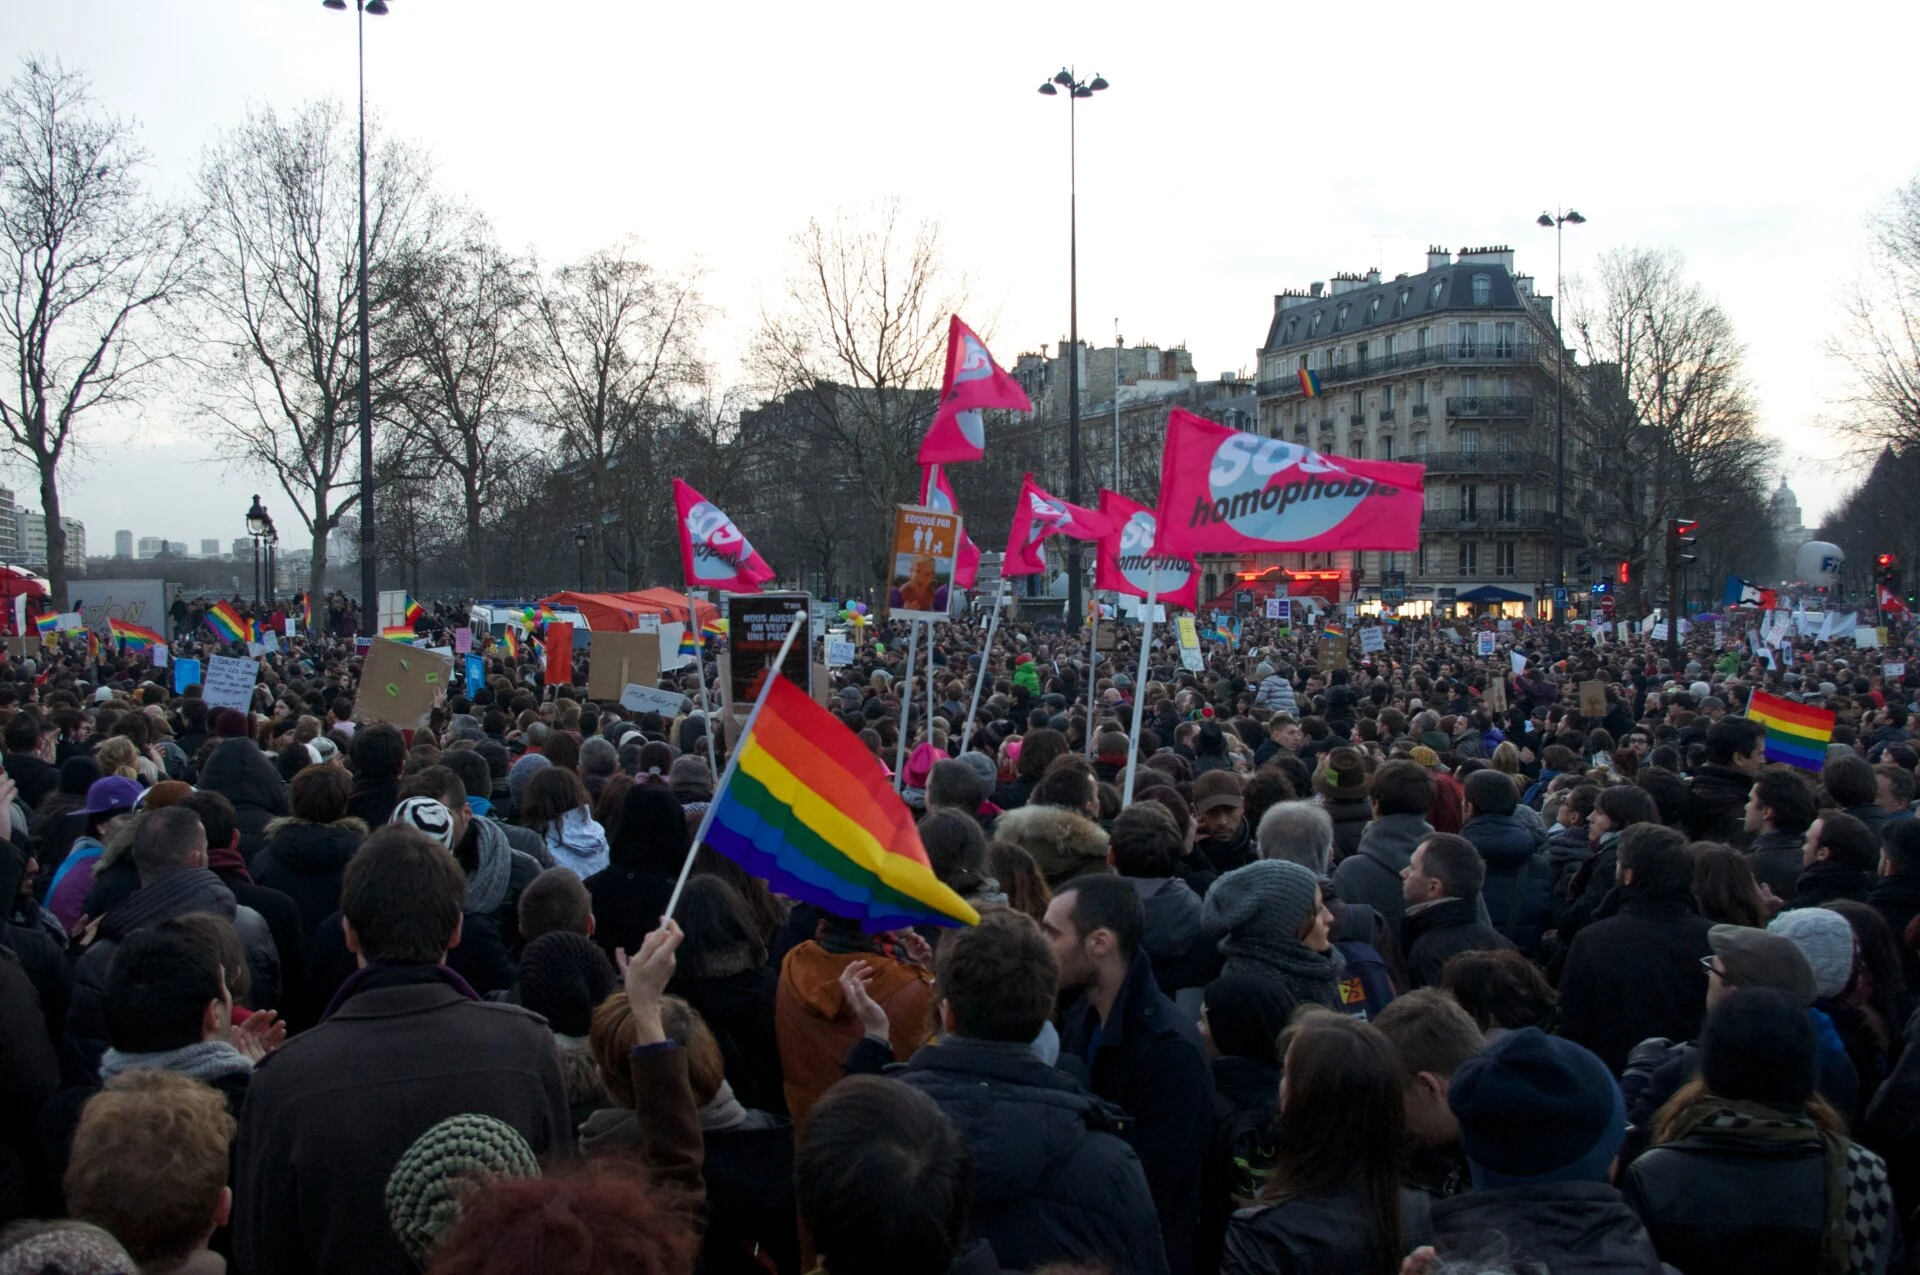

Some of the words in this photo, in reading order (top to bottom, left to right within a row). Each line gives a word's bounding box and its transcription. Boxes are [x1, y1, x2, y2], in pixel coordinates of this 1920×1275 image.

[937, 518, 951, 528] PAR
[743, 614, 767, 622] NOUS
[751, 623, 764, 632] ON
[765, 623, 787, 632] VEUT
[747, 632, 765, 640] UNE
